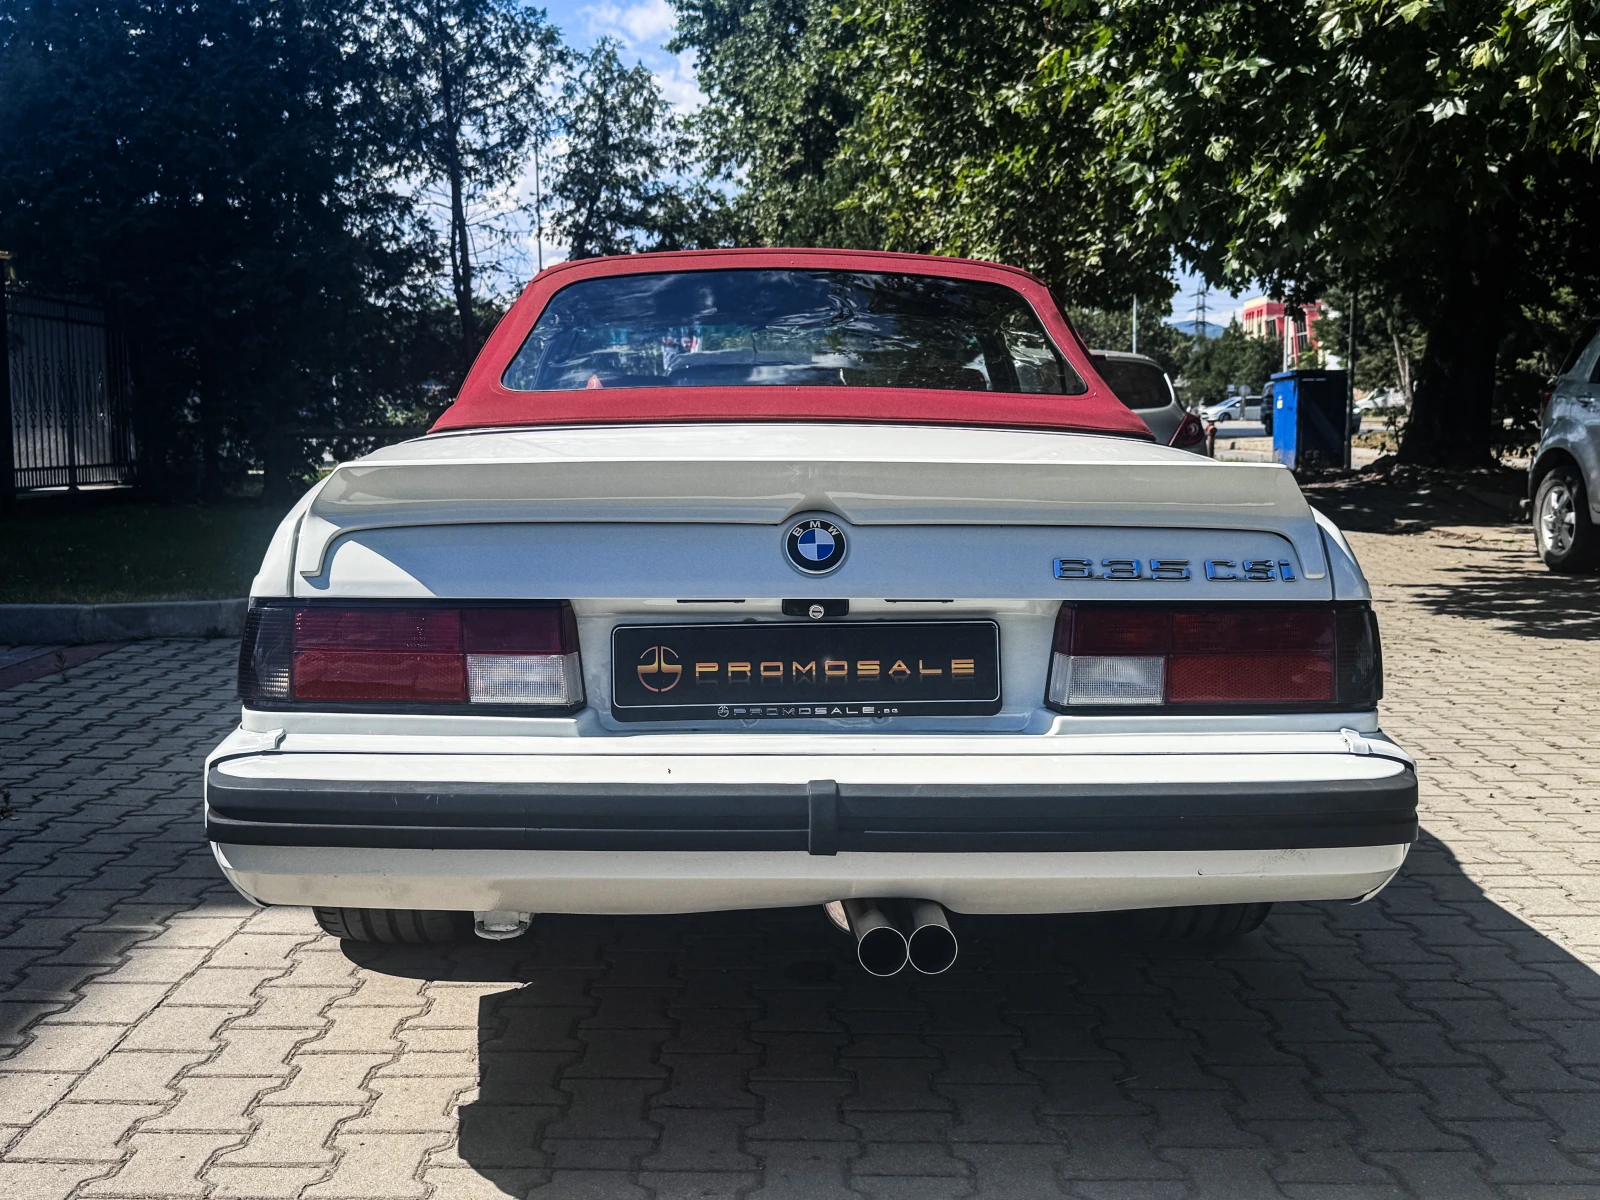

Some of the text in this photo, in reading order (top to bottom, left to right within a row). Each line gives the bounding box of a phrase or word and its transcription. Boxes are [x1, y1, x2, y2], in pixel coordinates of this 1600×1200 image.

[792, 520, 840, 537] BMW
[1053, 557, 1192, 582] 635
[695, 659, 975, 677] PROMOSALE
